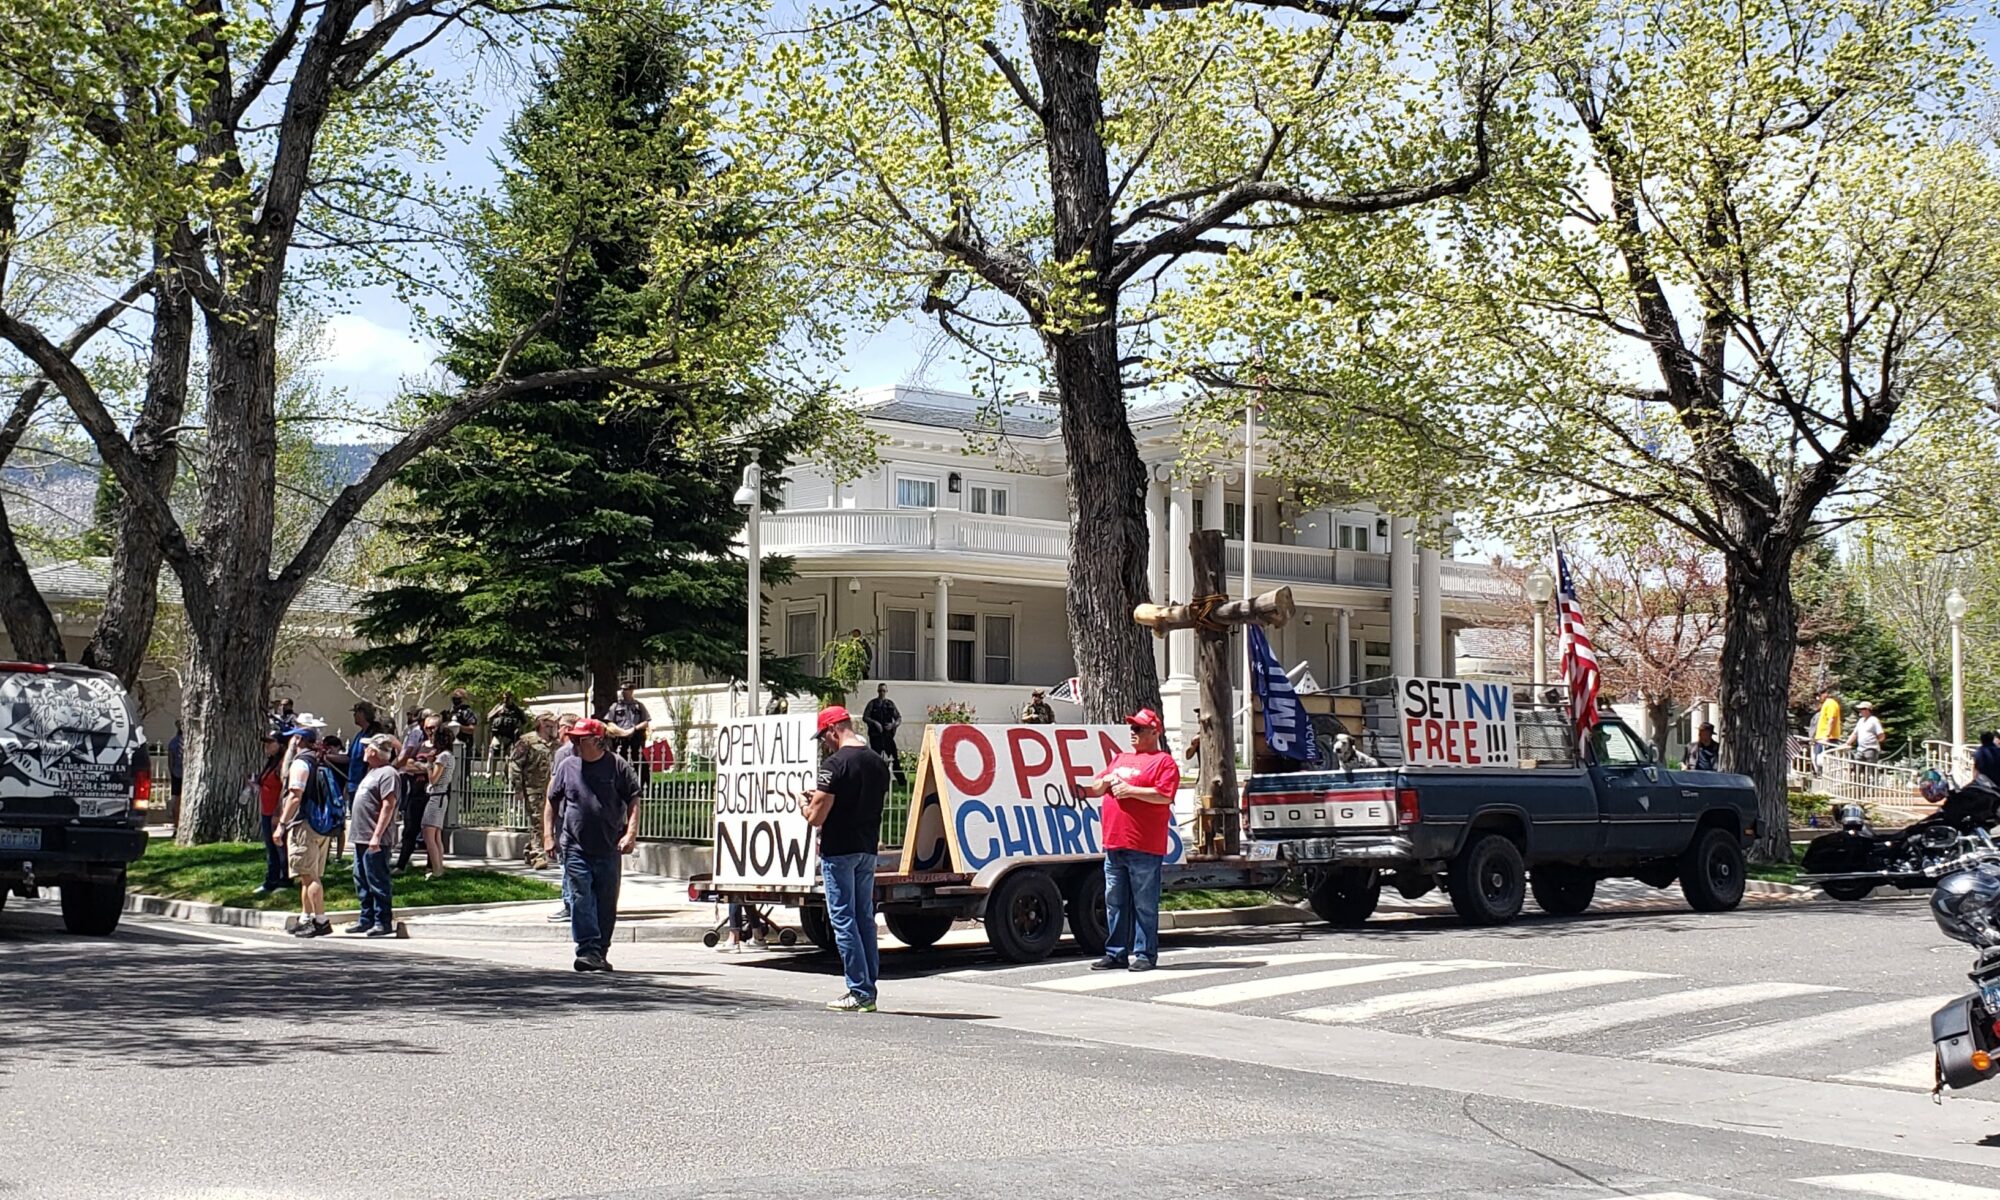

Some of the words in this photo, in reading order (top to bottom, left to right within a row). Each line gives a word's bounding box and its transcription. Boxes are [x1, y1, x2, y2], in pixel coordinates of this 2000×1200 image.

[1405, 680, 1461, 720] SET
[1464, 683, 1508, 721] NV
[718, 723, 765, 766] OPEN
[770, 721, 808, 765] ALL
[115, 764, 127, 773] LN
[1043, 783, 1096, 812] OUR
[1263, 807, 1381, 821] DODGE
[715, 820, 813, 879] NOW
